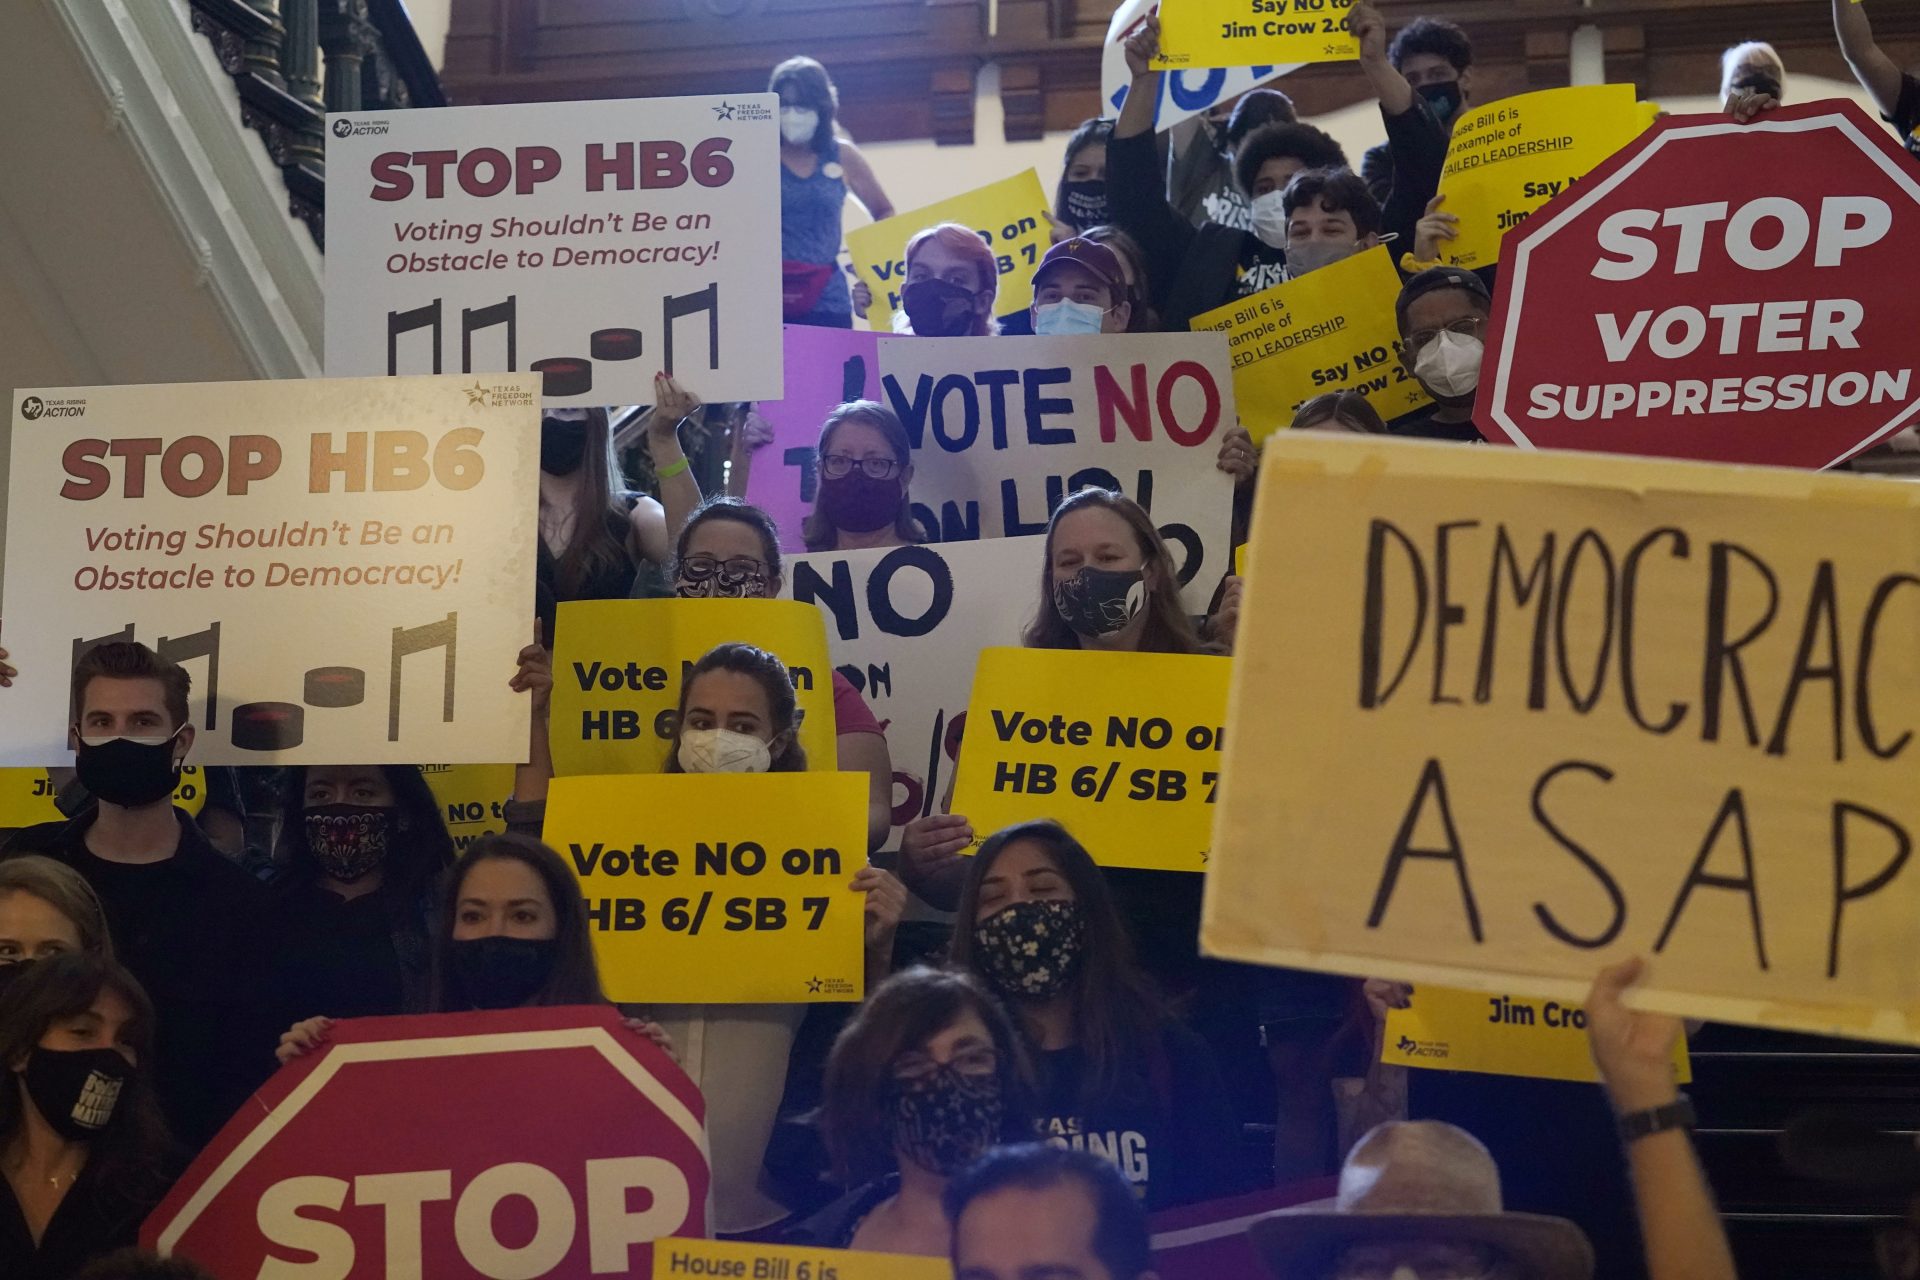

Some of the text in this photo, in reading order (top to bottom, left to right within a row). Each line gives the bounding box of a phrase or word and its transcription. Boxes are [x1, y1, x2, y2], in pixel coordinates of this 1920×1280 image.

[1222, 22, 1257, 39] Jim
[1263, 21, 1316, 36] Crow
[352, 126, 389, 136] ACTION
[1476, 112, 1495, 129] Bill
[1497, 110, 1506, 122] 6
[1508, 107, 1519, 120] is
[1456, 128, 1506, 154] example
[1508, 122, 1522, 137] of
[1482, 136, 1573, 164] LEADERSHIP
[369, 137, 735, 202] STOP HB6
[1523, 178, 1562, 198] Say
[394, 220, 482, 245] Voting
[632, 211, 667, 233] Be
[676, 213, 712, 231] an
[1001, 216, 1037, 241] on
[1496, 210, 1532, 229] Jim
[1021, 243, 1037, 265] 7
[1590, 196, 1892, 281] STOP
[386, 240, 720, 274] Obstacle to Democracy!
[871, 260, 906, 281] Vo
[1234, 306, 1258, 325] Bill
[1260, 303, 1271, 315] 6
[1270, 298, 1285, 311] is
[1278, 312, 1292, 328] of
[1256, 315, 1346, 359] LEADERSHIP
[1594, 298, 1865, 362] VOTER
[1311, 362, 1348, 387] Say
[1353, 346, 1388, 371] NO
[491, 399, 534, 407] NETWORK
[881, 366, 1077, 453] VOTE
[1093, 360, 1221, 448] NO
[1526, 368, 1912, 420] SUPPRESSION
[43, 406, 86, 417] ACTION
[59, 427, 486, 502] STOP HB6
[85, 523, 187, 556] Voting
[360, 520, 402, 544] Be
[412, 522, 454, 543] an
[74, 558, 463, 592] Obstacle to Democracy!
[792, 546, 954, 640] NO
[572, 661, 668, 692] Vote
[581, 710, 641, 741] HB
[991, 710, 1093, 746] Vote
[1105, 716, 1173, 750] NO
[31, 778, 58, 796] Ji
[993, 761, 1219, 803] HB 6/ SB 7
[448, 801, 504, 822] NO t
[569, 841, 841, 877] Vote NO on
[584, 891, 830, 935] HB 6/ SB 7
[1489, 995, 1588, 1030] Jim Cro
[256, 1155, 691, 1280] STOP
[670, 1251, 838, 1280] House Bill 6 is
